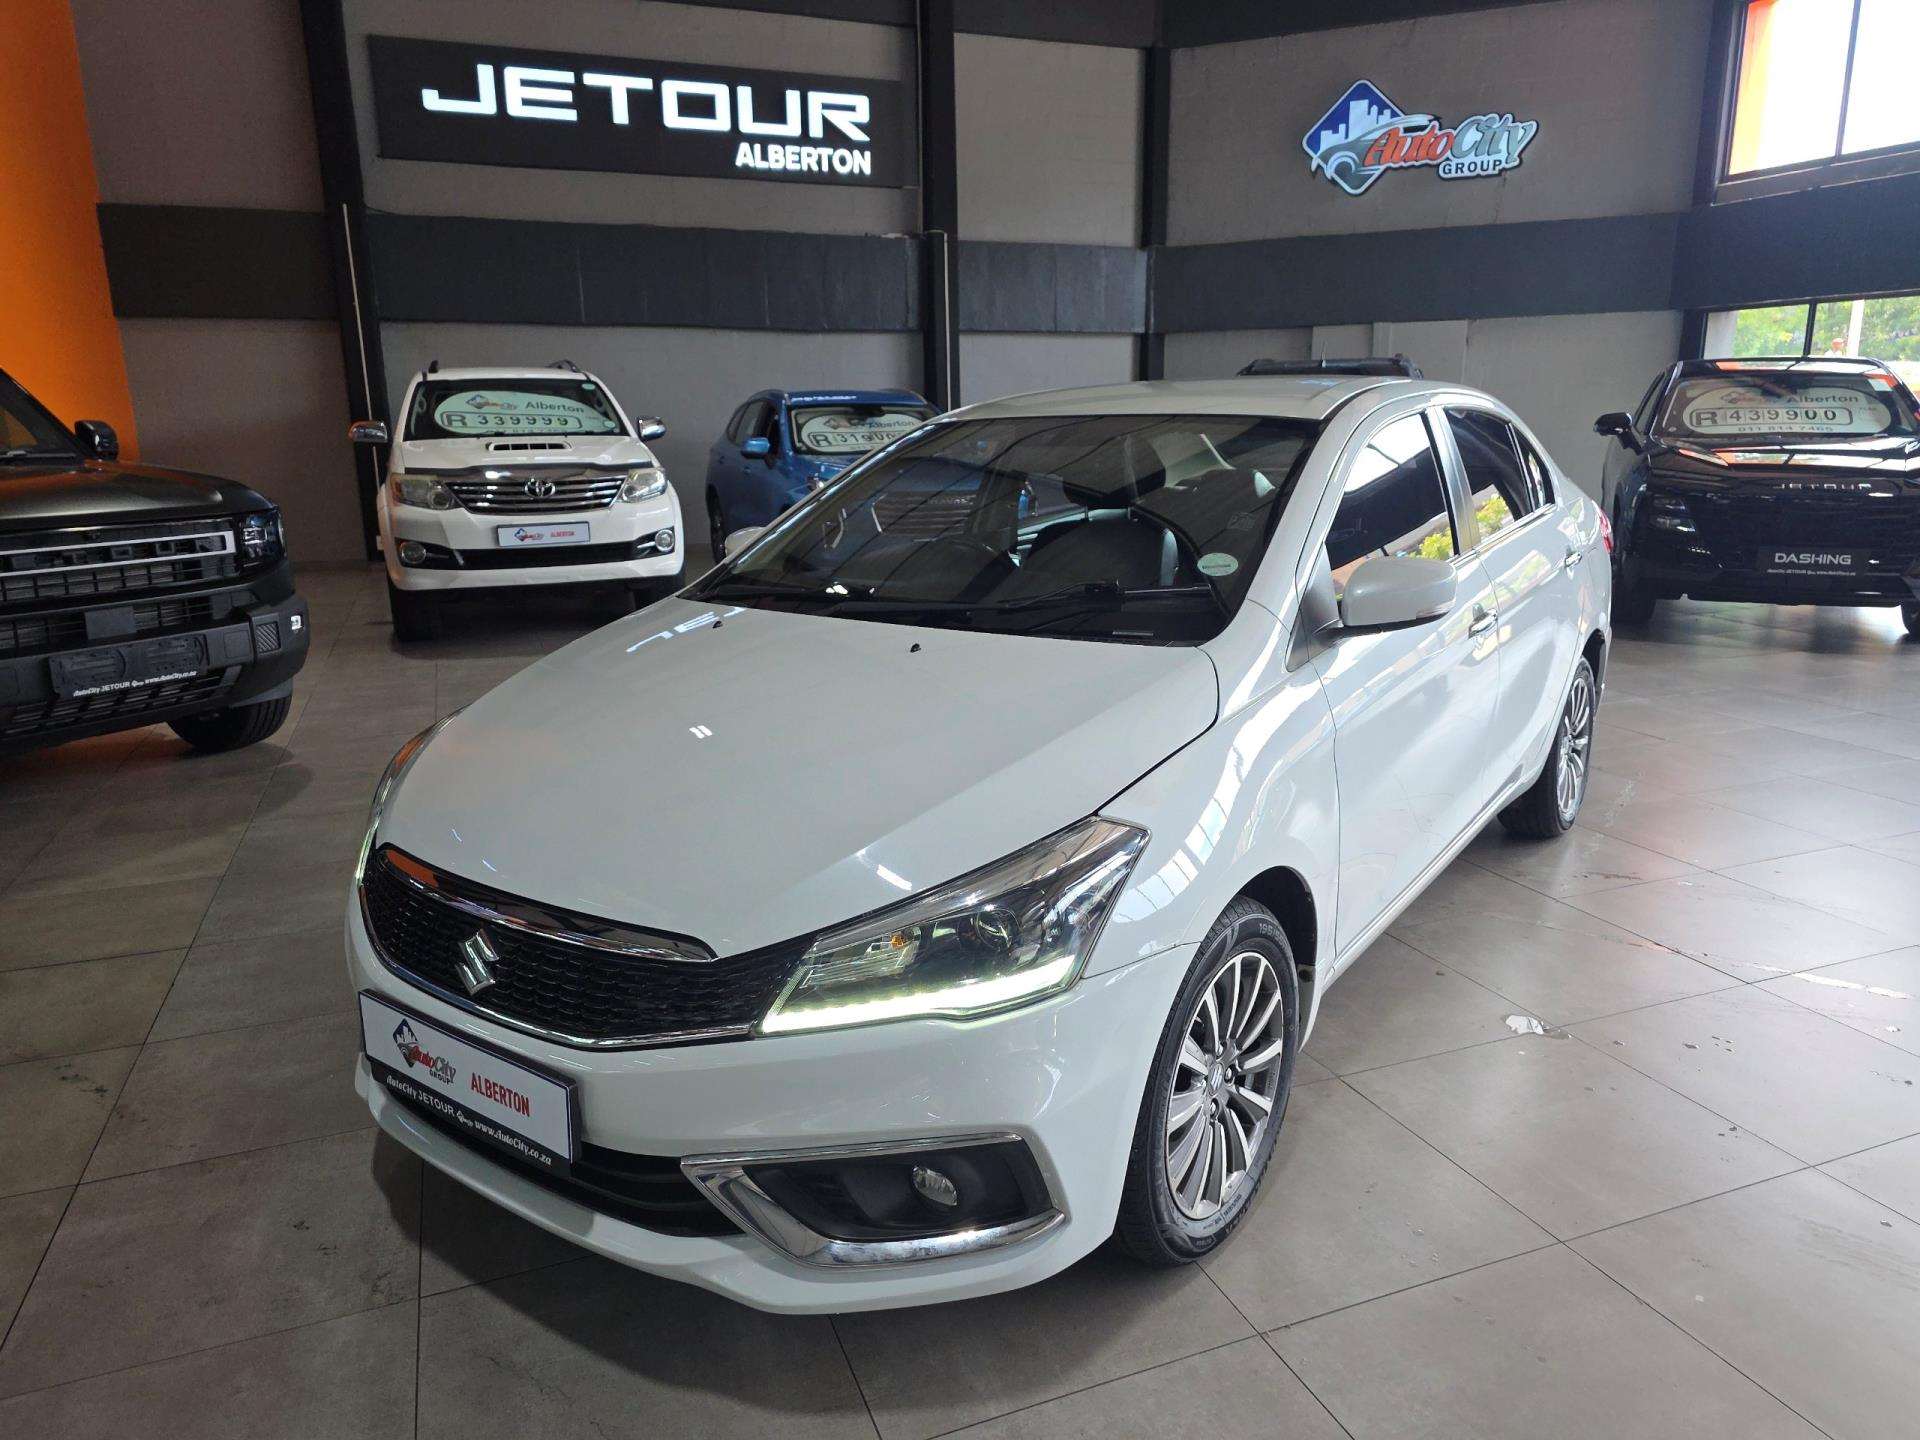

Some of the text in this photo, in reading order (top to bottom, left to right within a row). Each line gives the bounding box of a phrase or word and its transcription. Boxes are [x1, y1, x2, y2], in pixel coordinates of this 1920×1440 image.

[421, 63, 871, 142] JETOUR
[1363, 114, 1536, 167] AutoCity
[735, 142, 871, 175] ALBERTON
[1442, 159, 1503, 175] GROUP
[525, 401, 584, 413] Alberton
[1787, 395, 1858, 404] Alberton
[446, 413, 568, 428] R 339999
[1695, 409, 1837, 425] R 439900
[1774, 552, 1852, 565] DASHING
[101, 681, 131, 692] JETOUR
[429, 1069, 451, 1085] GROUP
[470, 1072, 530, 1117] ALBERTON
[386, 1074, 417, 1100] AutoCity
[418, 1089, 455, 1117] JETOUR
[475, 1119, 552, 1166] www.AutoCity.co.za
